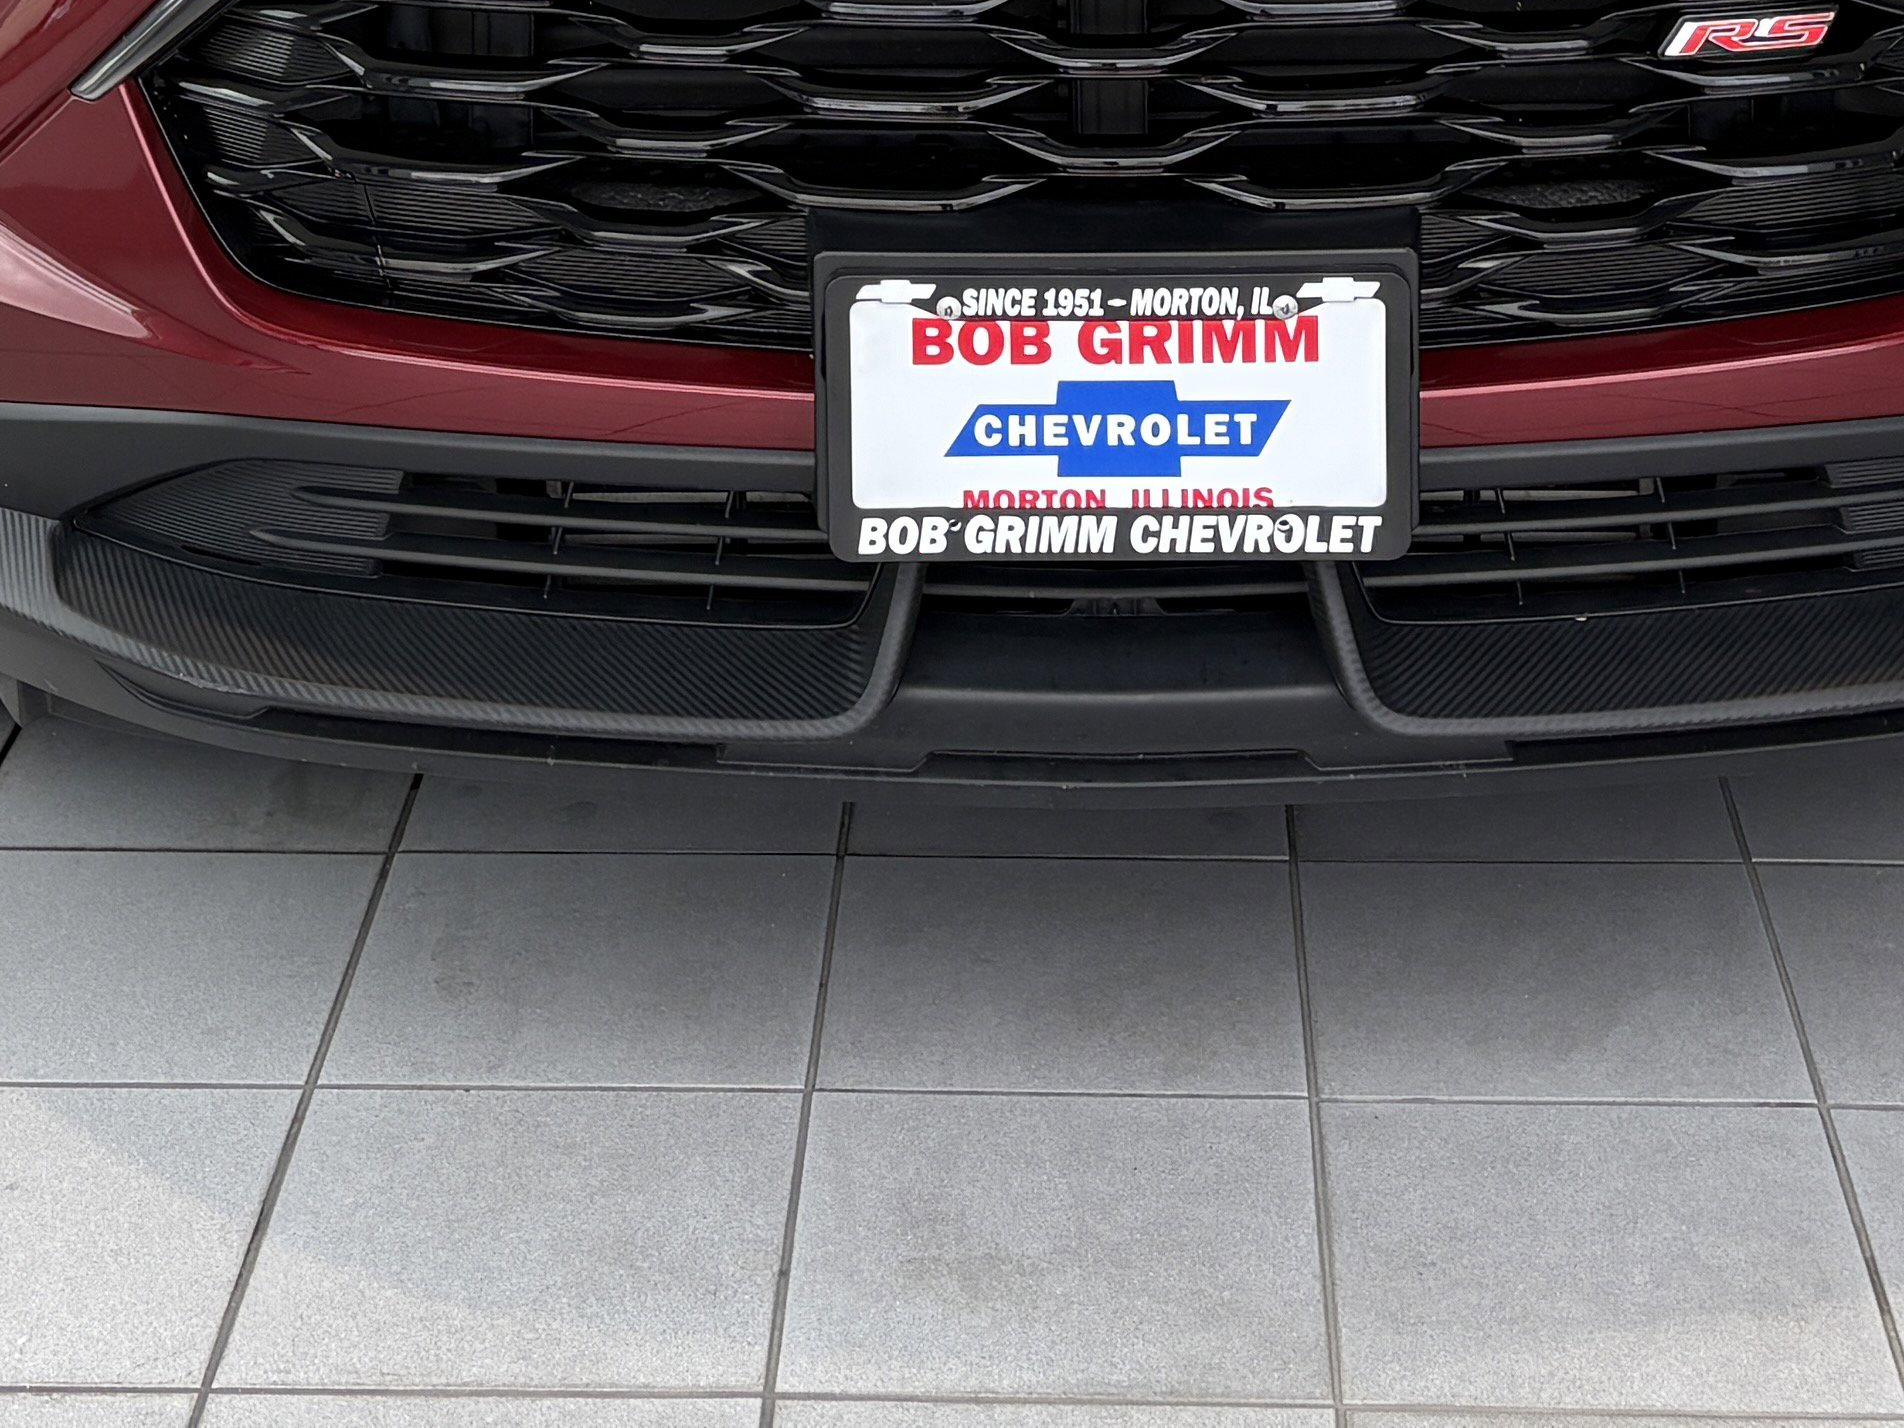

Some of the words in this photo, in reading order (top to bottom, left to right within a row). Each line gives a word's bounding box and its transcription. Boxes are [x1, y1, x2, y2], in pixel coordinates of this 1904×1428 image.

[1664, 12, 1836, 56] RS
[962, 288, 1038, 317] SINCE
[1042, 288, 1105, 317] 1951
[1130, 286, 1244, 320] MORTON,
[1250, 286, 1273, 316] IL
[911, 317, 1052, 365] BOB
[1077, 316, 1319, 365] GRIMM
[973, 412, 1258, 447] CHEVROLET
[857, 516, 951, 555] BOB
[963, 515, 1117, 554] GRIMM
[1130, 514, 1383, 554] CHEVROLET
